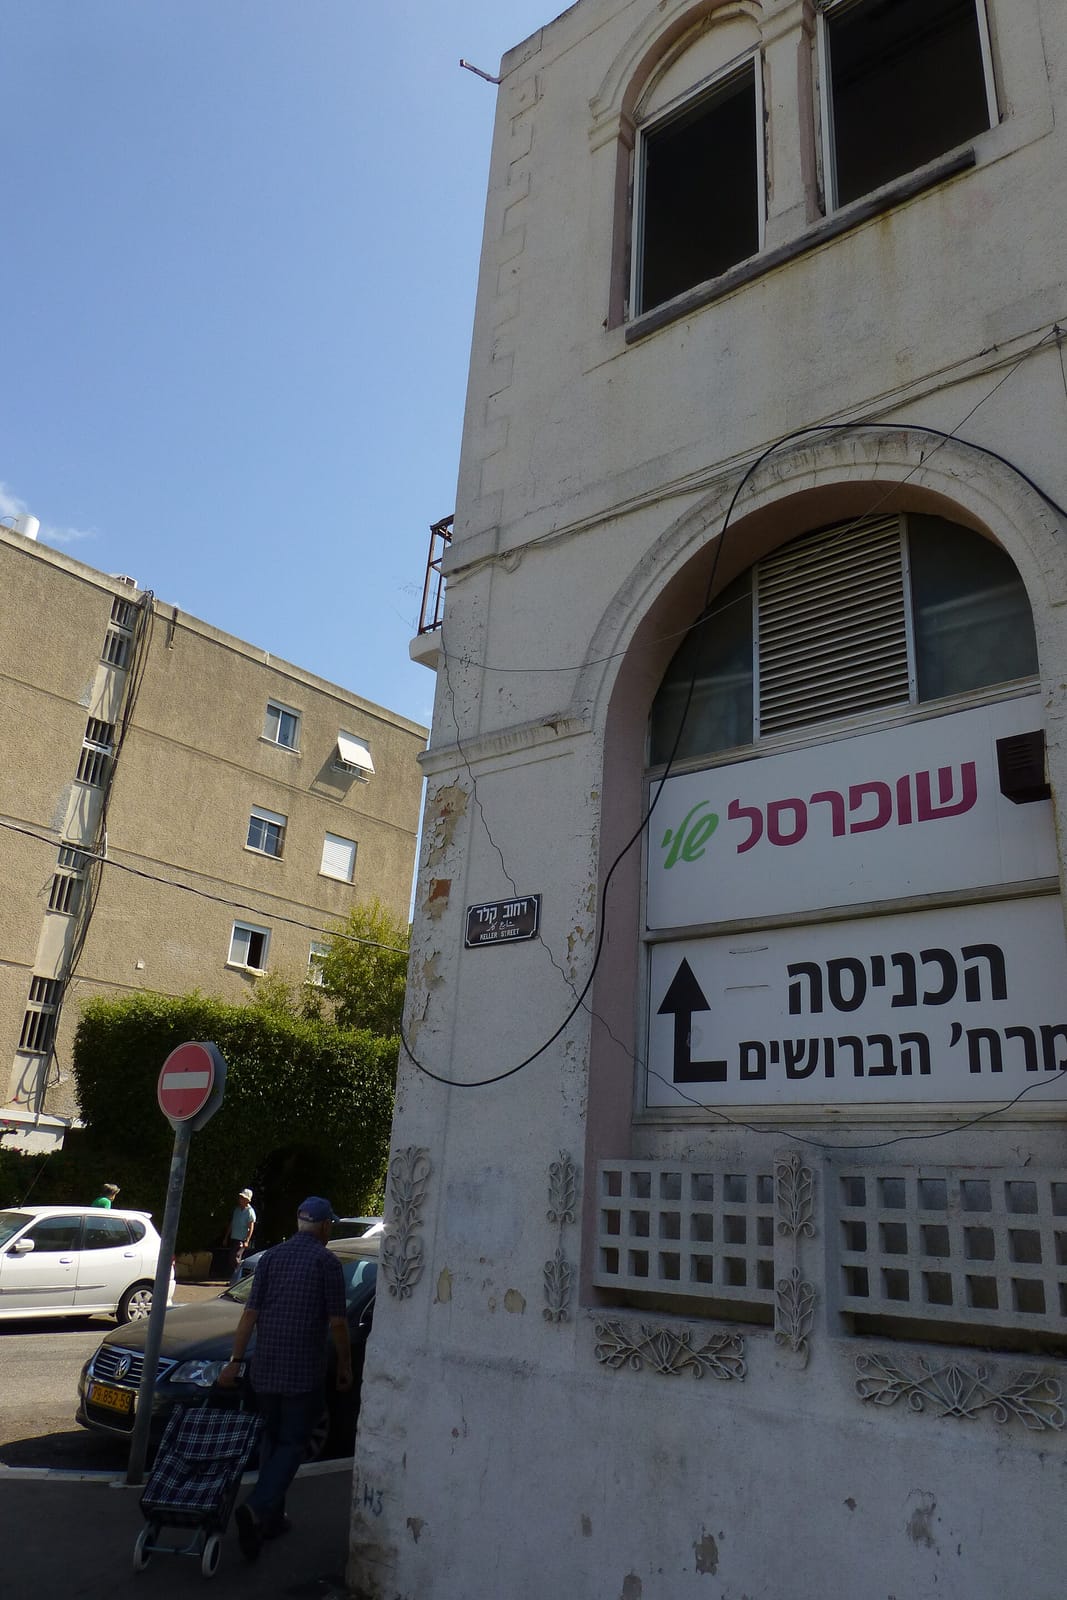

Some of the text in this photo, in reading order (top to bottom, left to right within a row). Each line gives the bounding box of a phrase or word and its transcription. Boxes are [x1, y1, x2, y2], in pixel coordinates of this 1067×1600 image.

[660, 761, 978, 870] שופרסל שלי
[476, 901, 528, 924] רחוב קלר
[480, 928, 520, 941] KELLER STREET
[786, 943, 1008, 1015] הכניסה
[738, 1031, 932, 1081] הברושים
